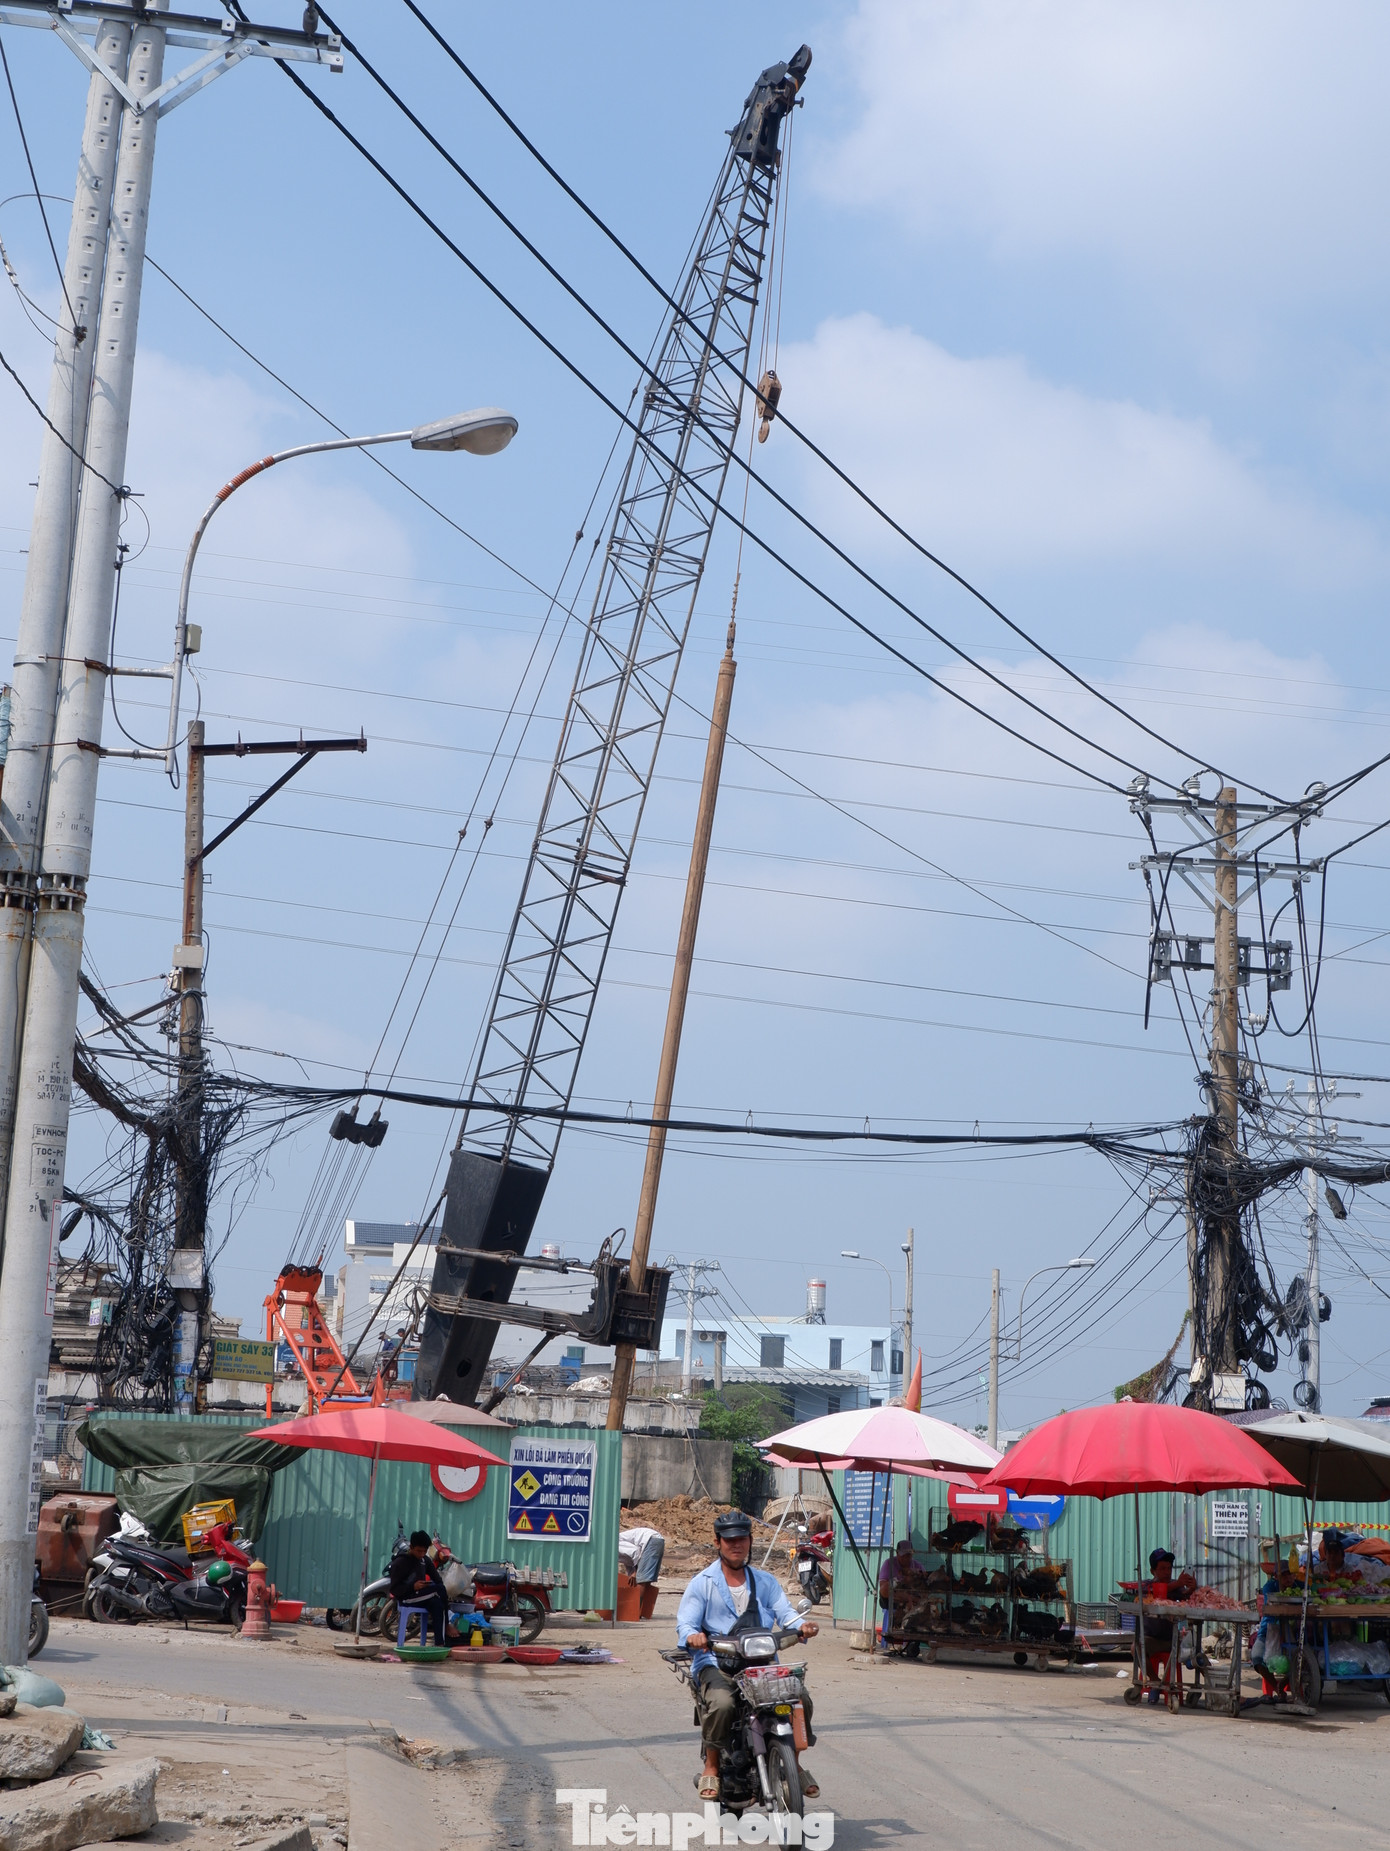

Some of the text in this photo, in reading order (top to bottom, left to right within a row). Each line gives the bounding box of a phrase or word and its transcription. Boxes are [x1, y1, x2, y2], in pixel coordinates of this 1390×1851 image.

[514, 1448, 524, 1462] XIN
[543, 1472, 561, 1486] CÔNG
[560, 1494, 570, 1506] THI
[572, 1492, 589, 1506] CÔNG
